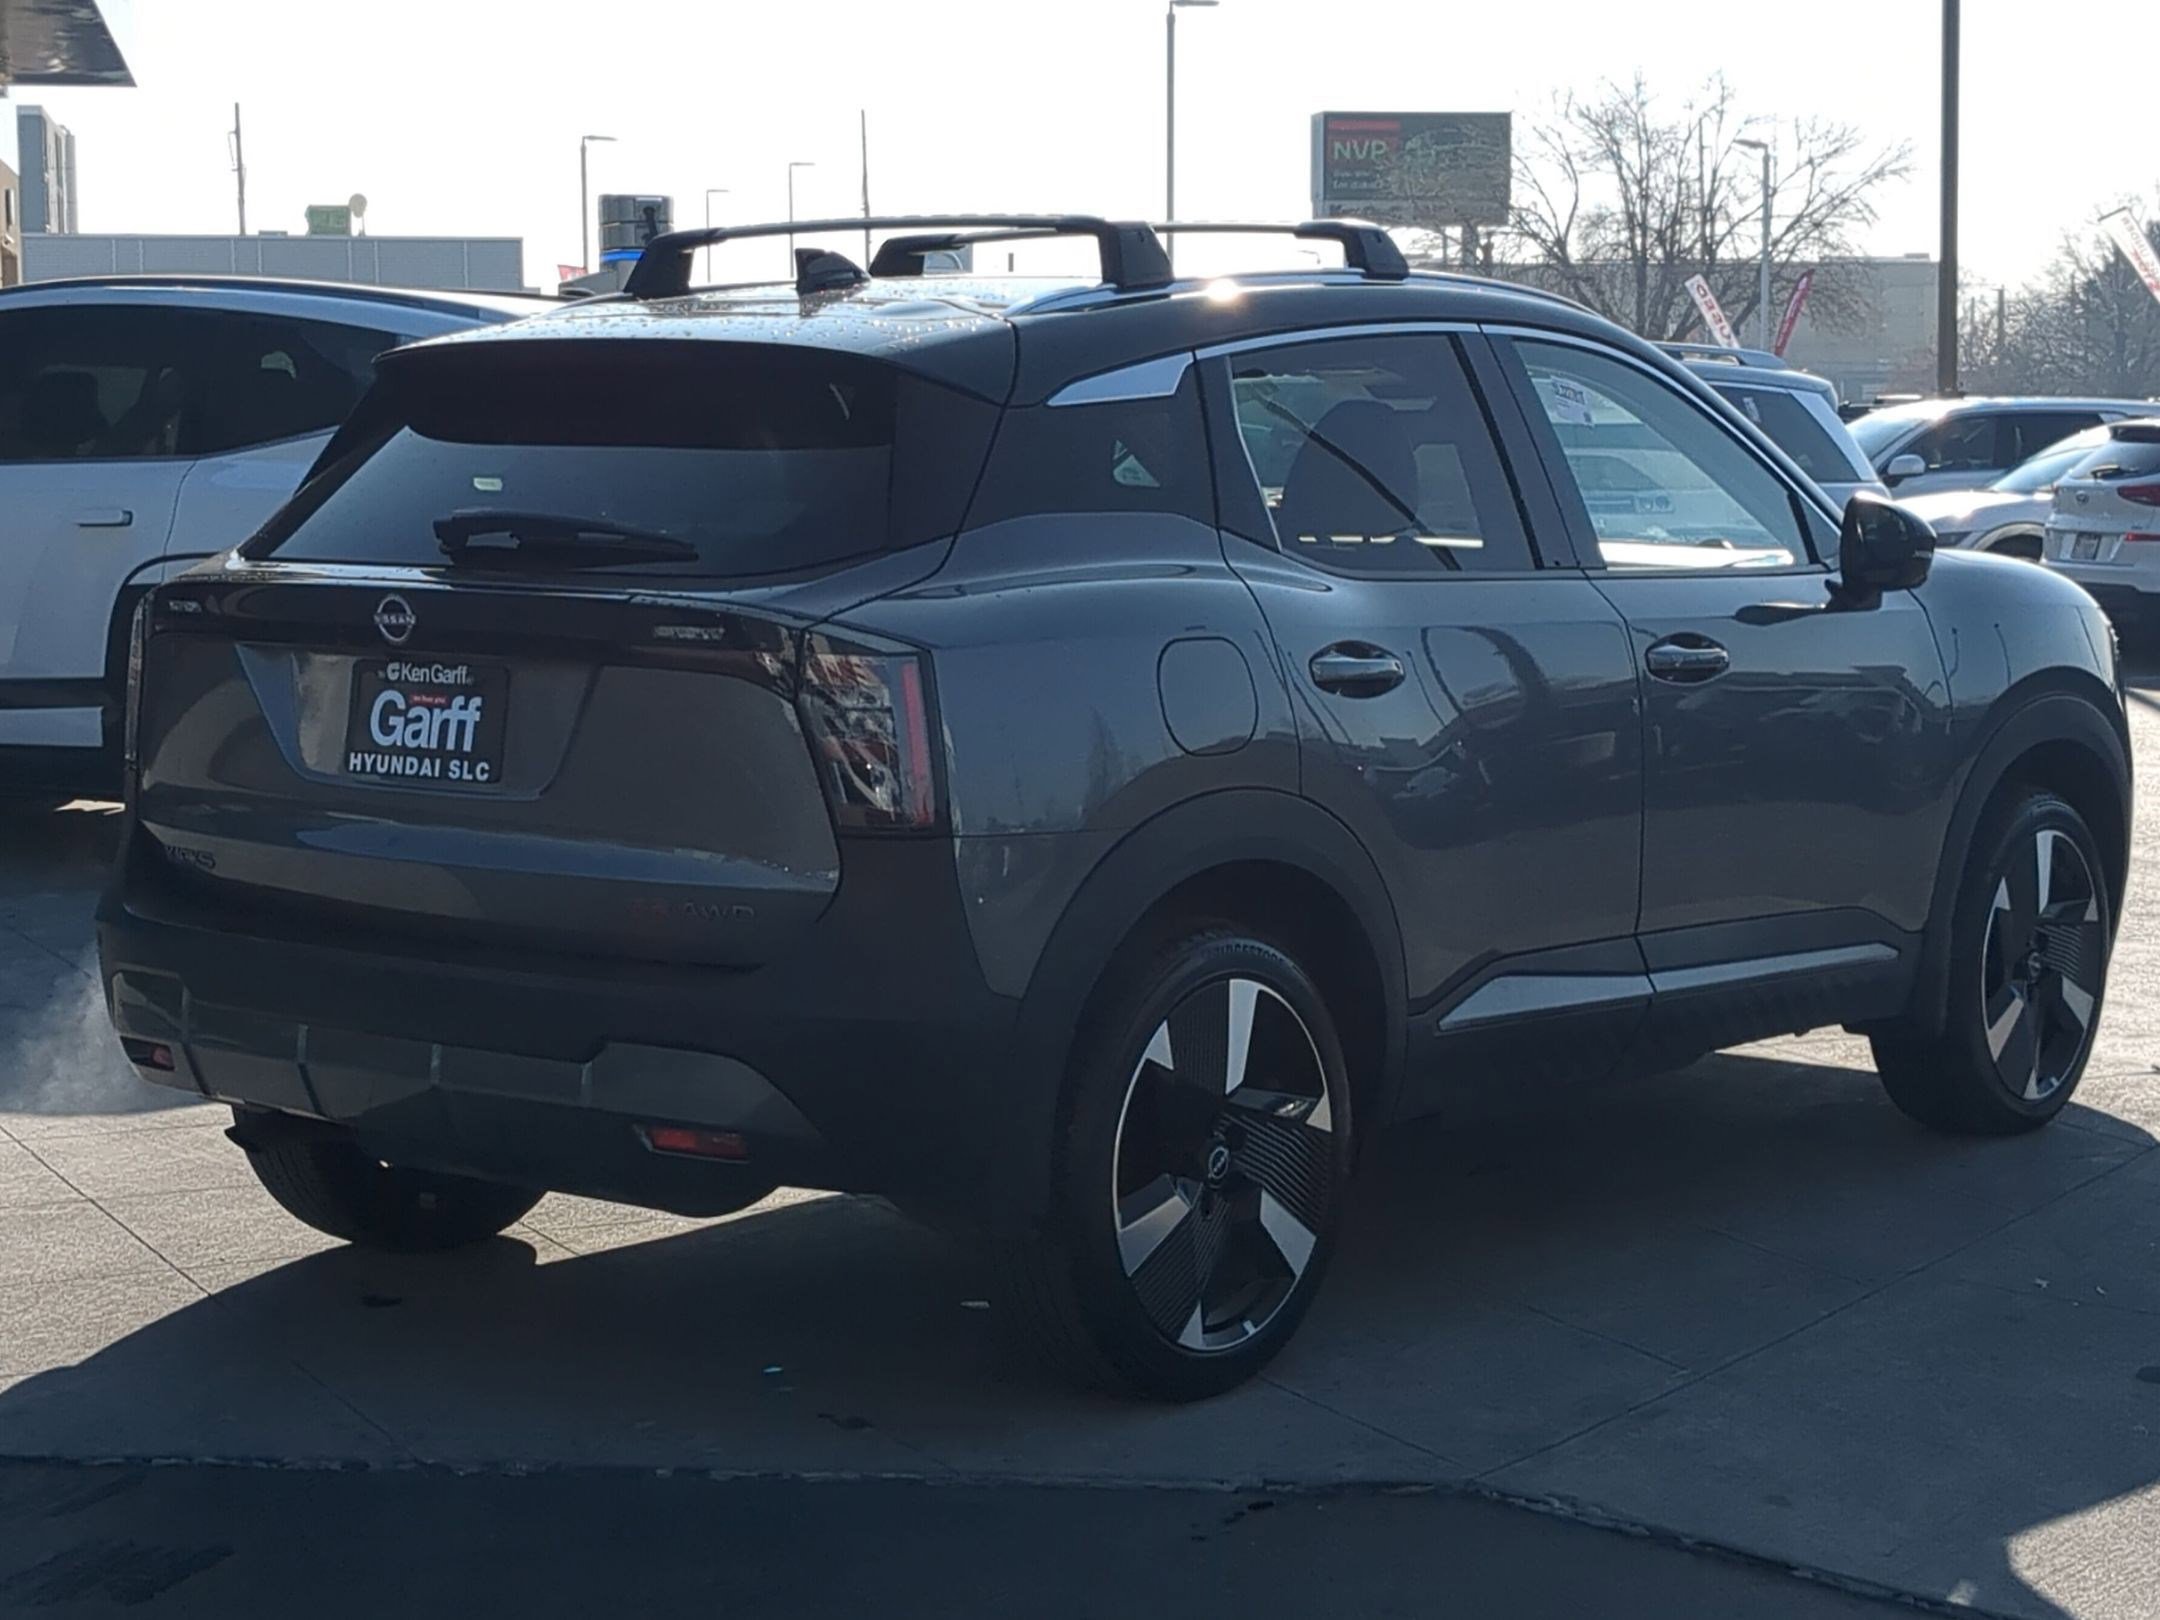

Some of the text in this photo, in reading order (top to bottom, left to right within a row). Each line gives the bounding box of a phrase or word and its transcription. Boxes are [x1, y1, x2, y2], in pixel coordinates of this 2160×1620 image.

[401, 662, 468, 685] Ken Garff
[370, 689, 482, 753] Garff
[349, 752, 490, 782] HYUNDAI SLC
[682, 901, 756, 921] AWD
